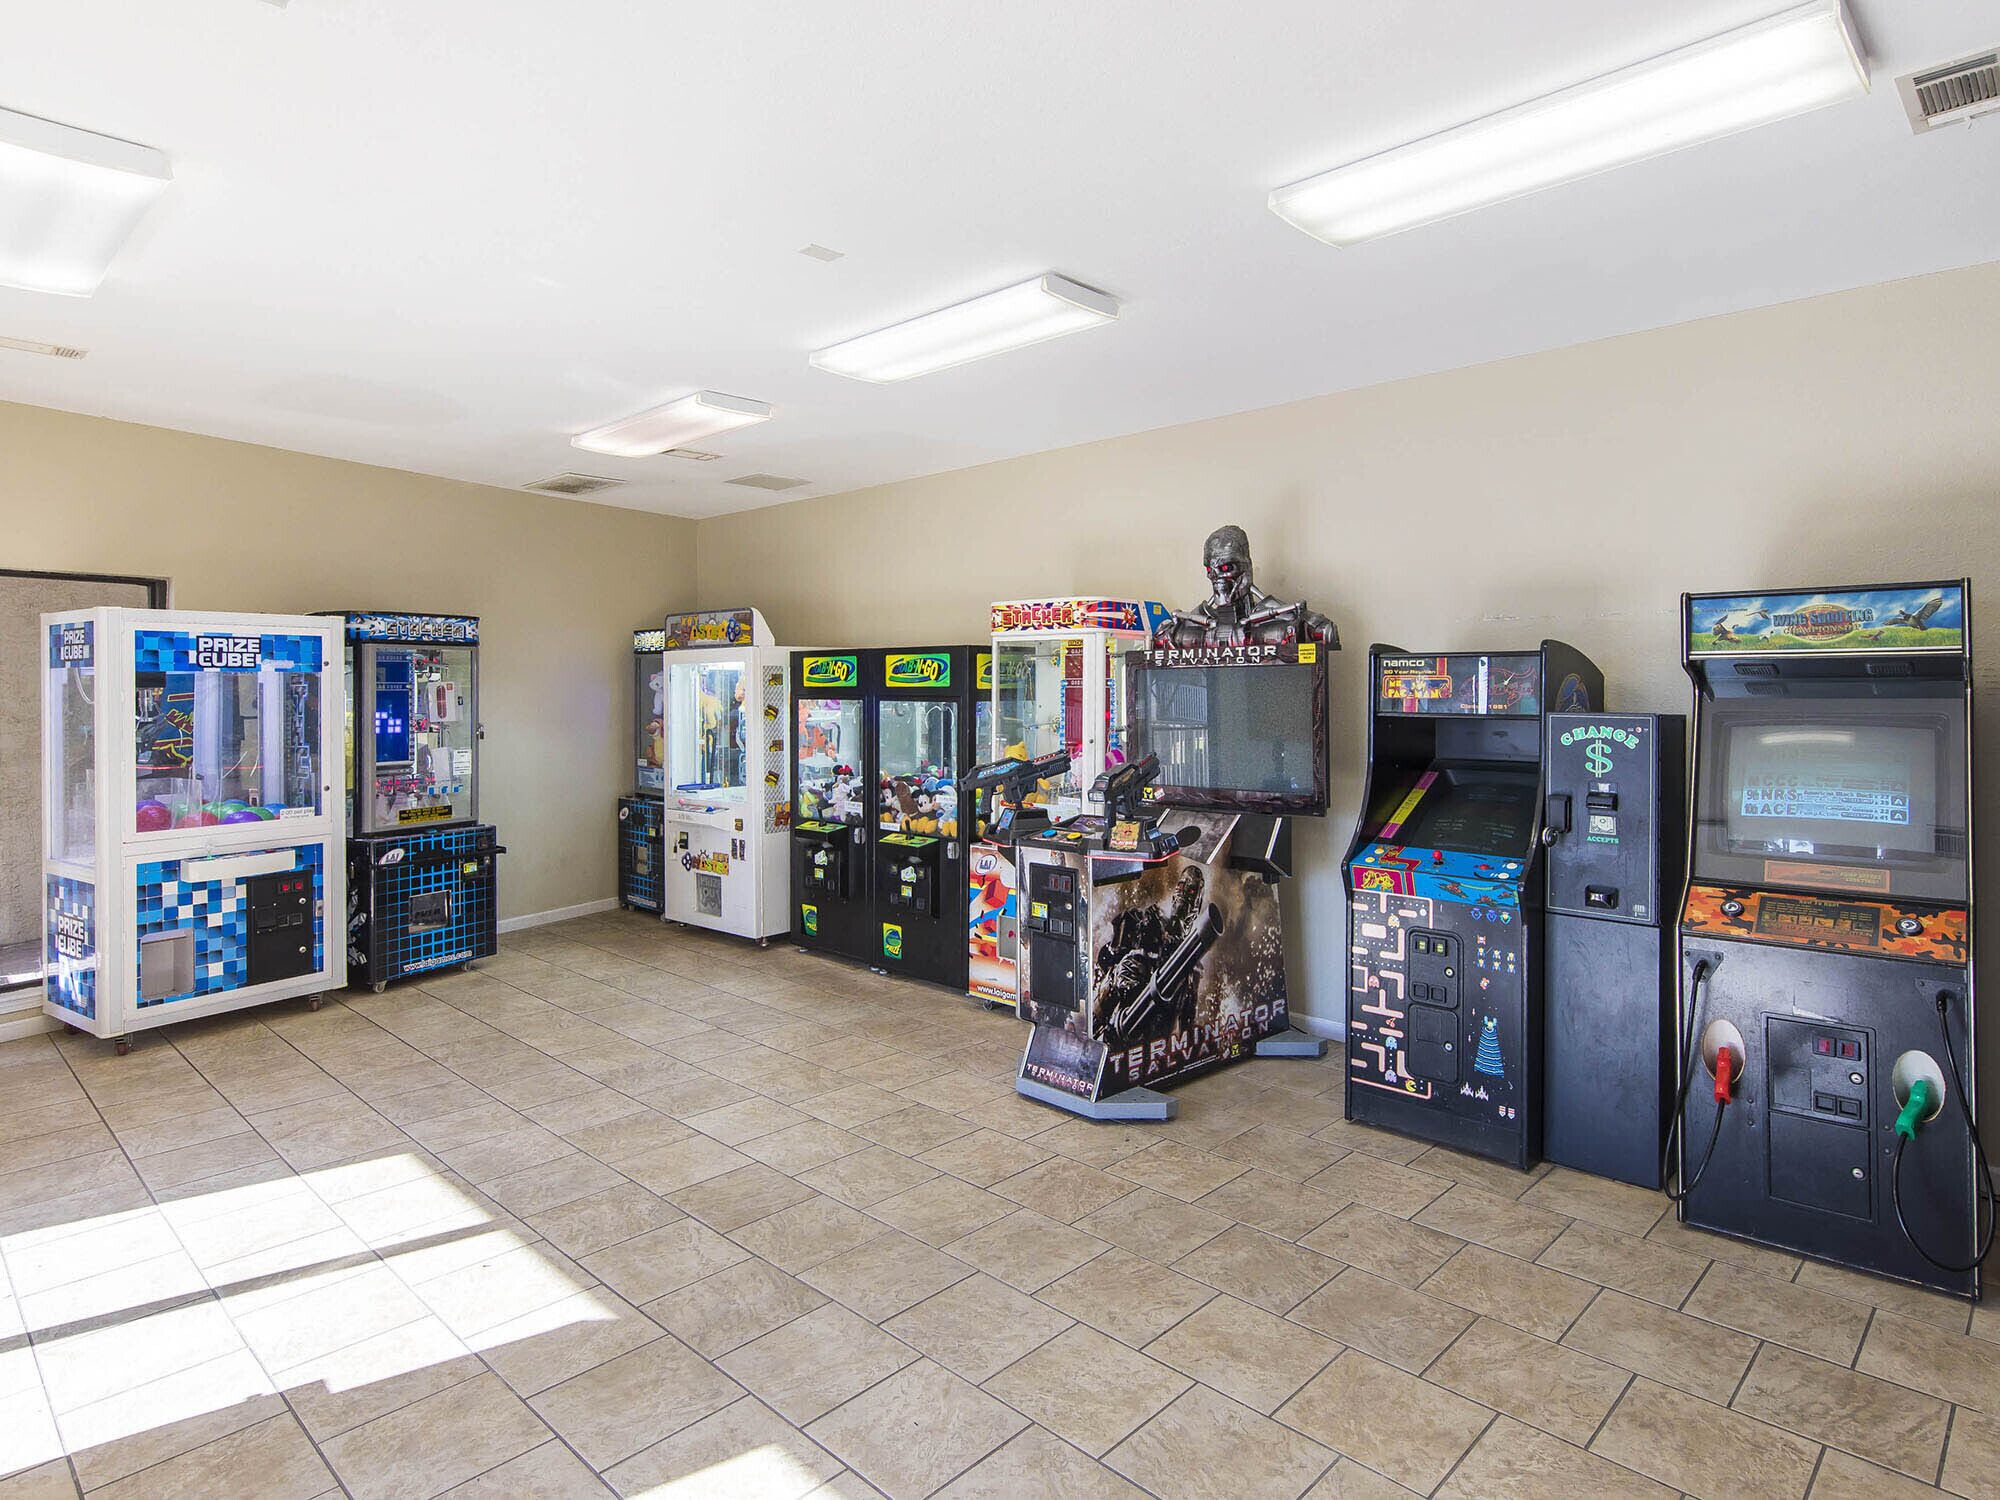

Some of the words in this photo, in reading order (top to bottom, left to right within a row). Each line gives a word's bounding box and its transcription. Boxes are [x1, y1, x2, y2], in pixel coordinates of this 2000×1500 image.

[1001, 606, 1073, 627] STACKER
[1773, 613, 1807, 627] WING
[1809, 608, 1874, 625] SHOOTING
[64, 628, 85, 645] PRIZE
[385, 620, 465, 638] STACKER
[64, 644, 83, 660] CUBE
[198, 637, 261, 653] PRIZE
[1143, 645, 1277, 661] TERMINATOR
[198, 652, 256, 667] CUBE
[1154, 655, 1261, 667] SALVATION
[1383, 659, 1425, 667] namco
[1561, 726, 1640, 750] CHANGE
[1760, 802, 1798, 815] ACE
[1586, 835, 1620, 844] ACCEPTS
[979, 859, 993, 870] LAI
[58, 915, 85, 940] PRIZE
[58, 934, 82, 958] CUBE
[1109, 997, 1286, 1074] TERMINATOR
[1129, 1019, 1271, 1081] SALVATION
[1026, 1063, 1094, 1091] TERMINATOR
[1031, 1071, 1085, 1093] SALVATION
